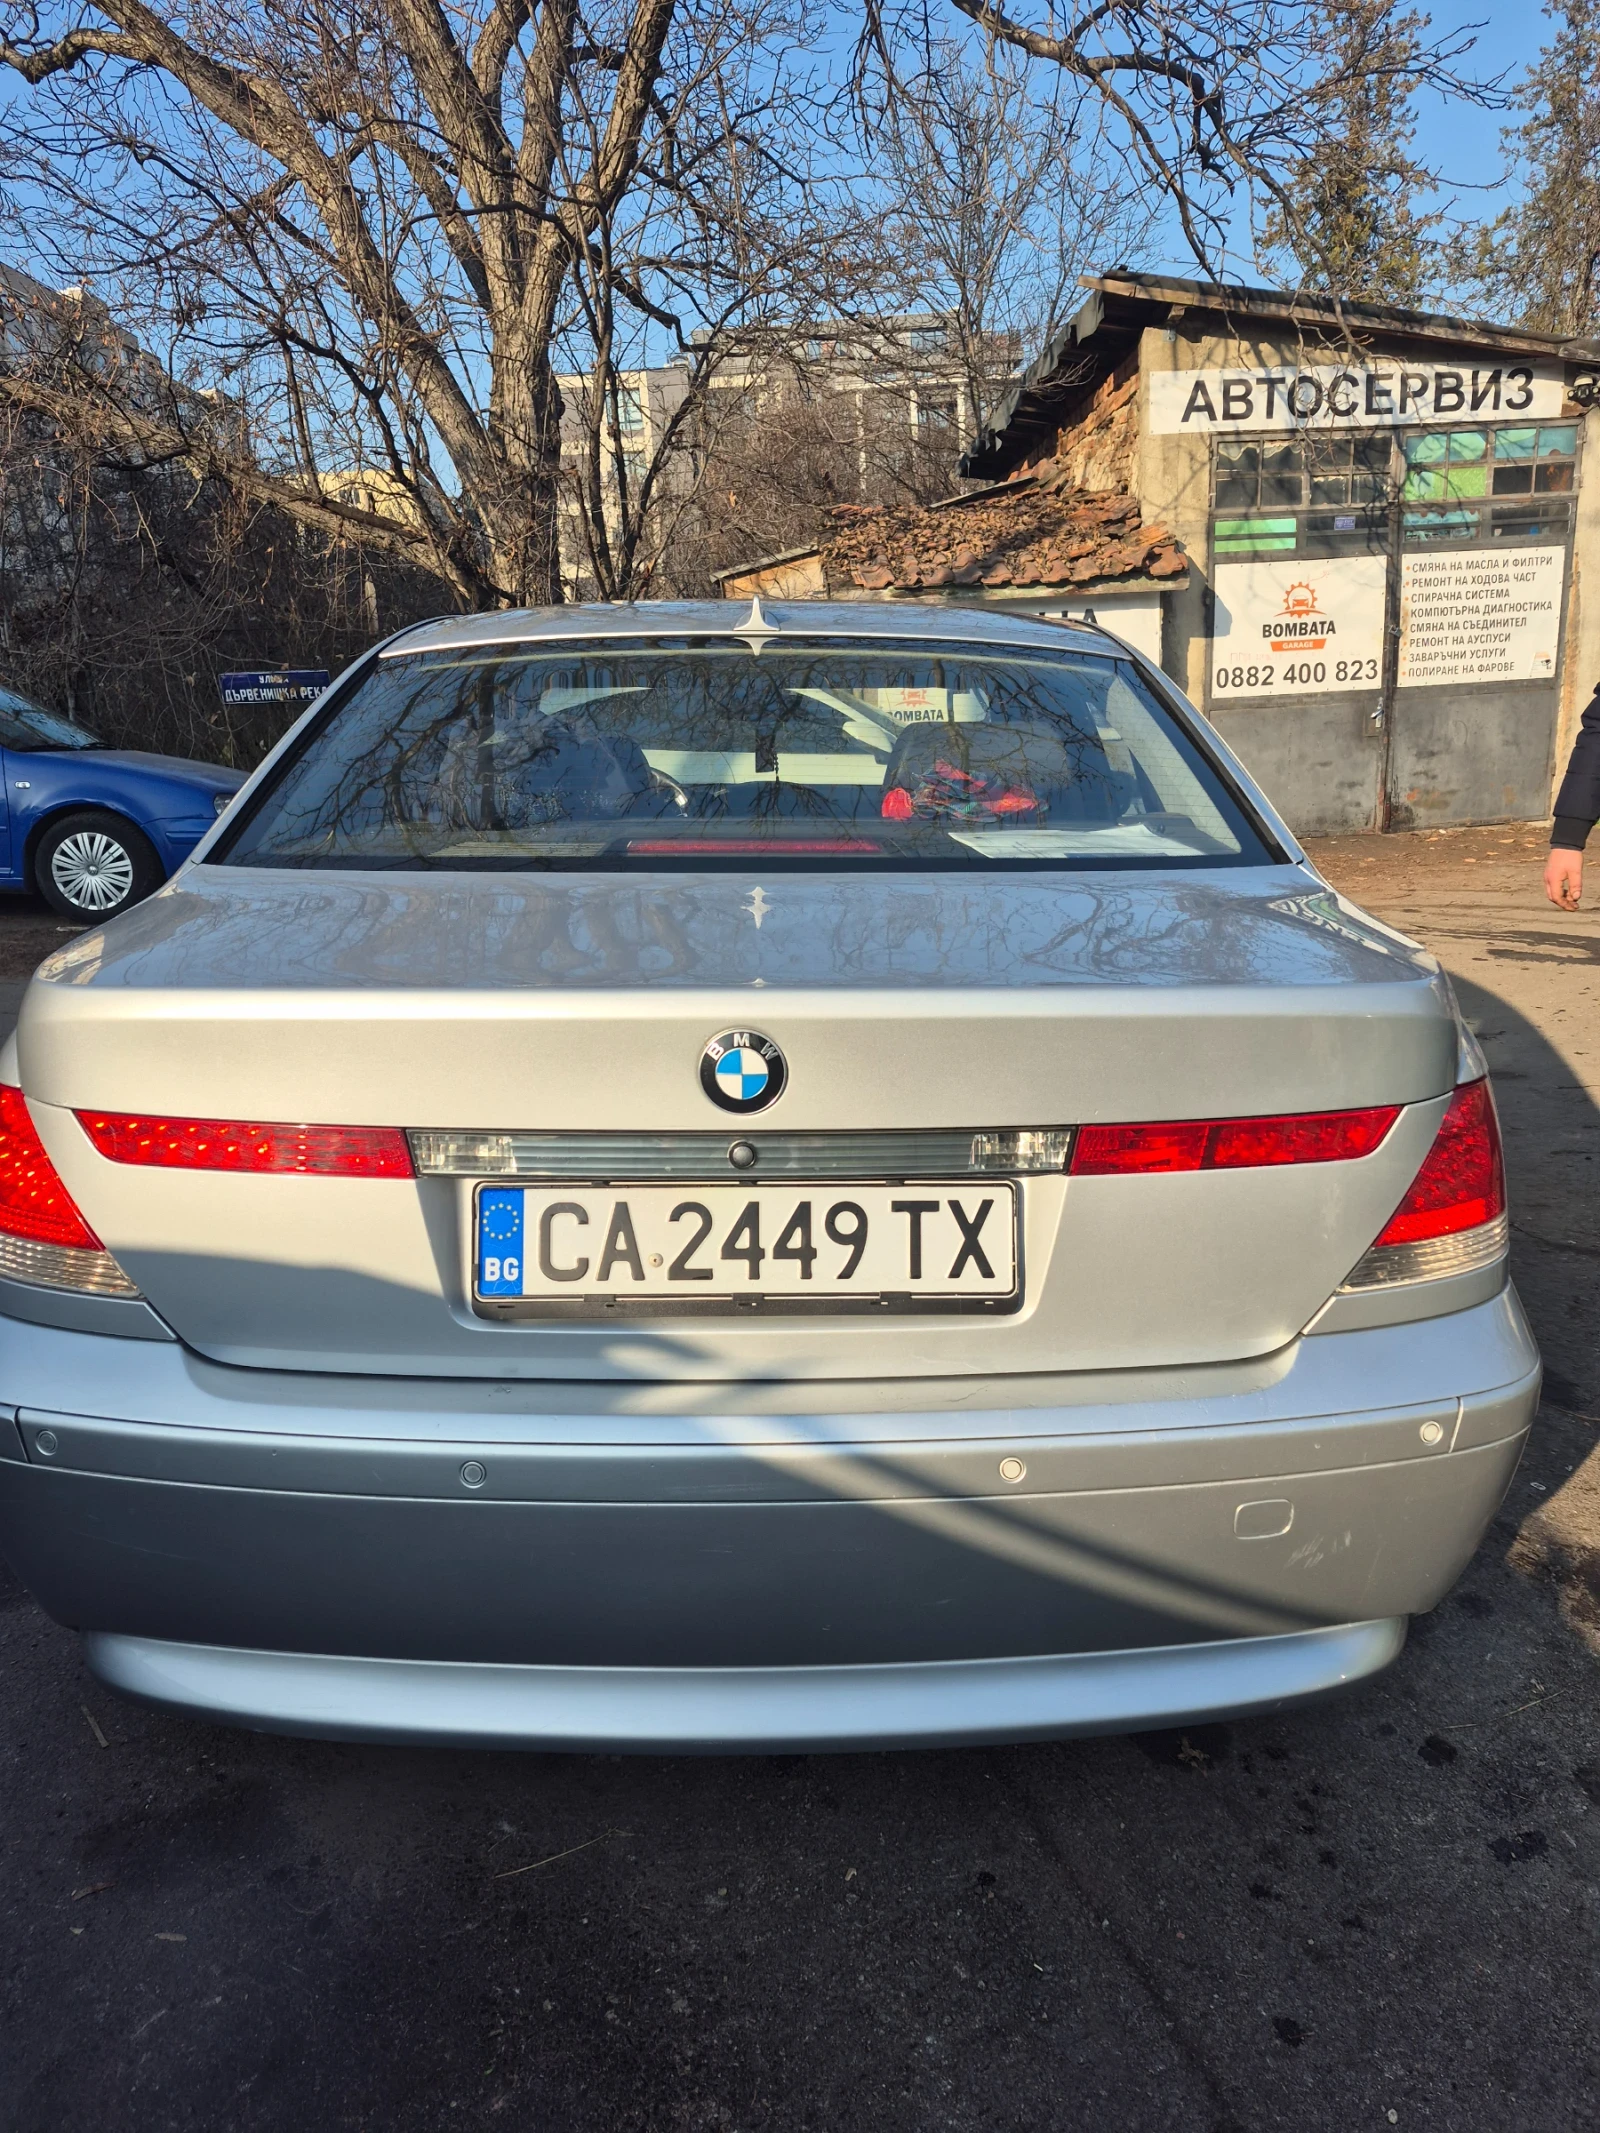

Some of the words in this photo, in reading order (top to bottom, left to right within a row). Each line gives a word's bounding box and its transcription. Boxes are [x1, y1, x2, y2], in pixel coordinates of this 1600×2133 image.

[1181, 367, 1534, 422] АВТОСЕРВИЗ
[1412, 562, 1447, 573] СМЯНА
[1450, 561, 1463, 571] НА
[1465, 559, 1500, 570] МАСЛА
[1502, 558, 1509, 568] И
[1512, 556, 1553, 567] ФИЛТРИ
[1412, 576, 1452, 588] РЕМОНТ
[1455, 576, 1468, 585] НА
[1470, 573, 1510, 586] ХОДОВА
[1513, 572, 1536, 582] ЧАСТ
[1411, 591, 1462, 603] СПИРАЧНА
[1465, 588, 1510, 600] СИСТЕМА
[1410, 605, 1480, 618] КОМПЮТЪРНА
[1482, 601, 1553, 616] ДИАГНОСТИКА
[1262, 620, 1336, 638] BOMBATA
[1410, 622, 1445, 633] СМЯНА
[1447, 621, 1460, 631] НА
[1462, 617, 1527, 631] СЪЕДИНИТЕЛ
[1282, 641, 1314, 649] GARAGE
[1409, 636, 1449, 648] РЕМОНТ
[1452, 636, 1465, 645] НА
[1467, 633, 1511, 644] АУСПУСИ
[1409, 650, 1467, 663] ЗАВАРЪЧНИ
[1469, 648, 1506, 660] УСЛУГИ
[1216, 665, 1275, 689] 0882
[1282, 662, 1326, 684] 400
[1335, 659, 1378, 682] 823
[1408, 665, 1459, 678] ПОЛИРАНЕ
[1462, 664, 1475, 674] НА
[1477, 661, 1515, 673] ФАРОВЕ
[888, 709, 944, 722] OMBATA
[707, 1033, 779, 1060] BMW
[539, 1201, 644, 1282] CA
[667, 1200, 868, 1281] 2449
[891, 1199, 995, 1280] TX
[484, 1257, 519, 1282] BG
